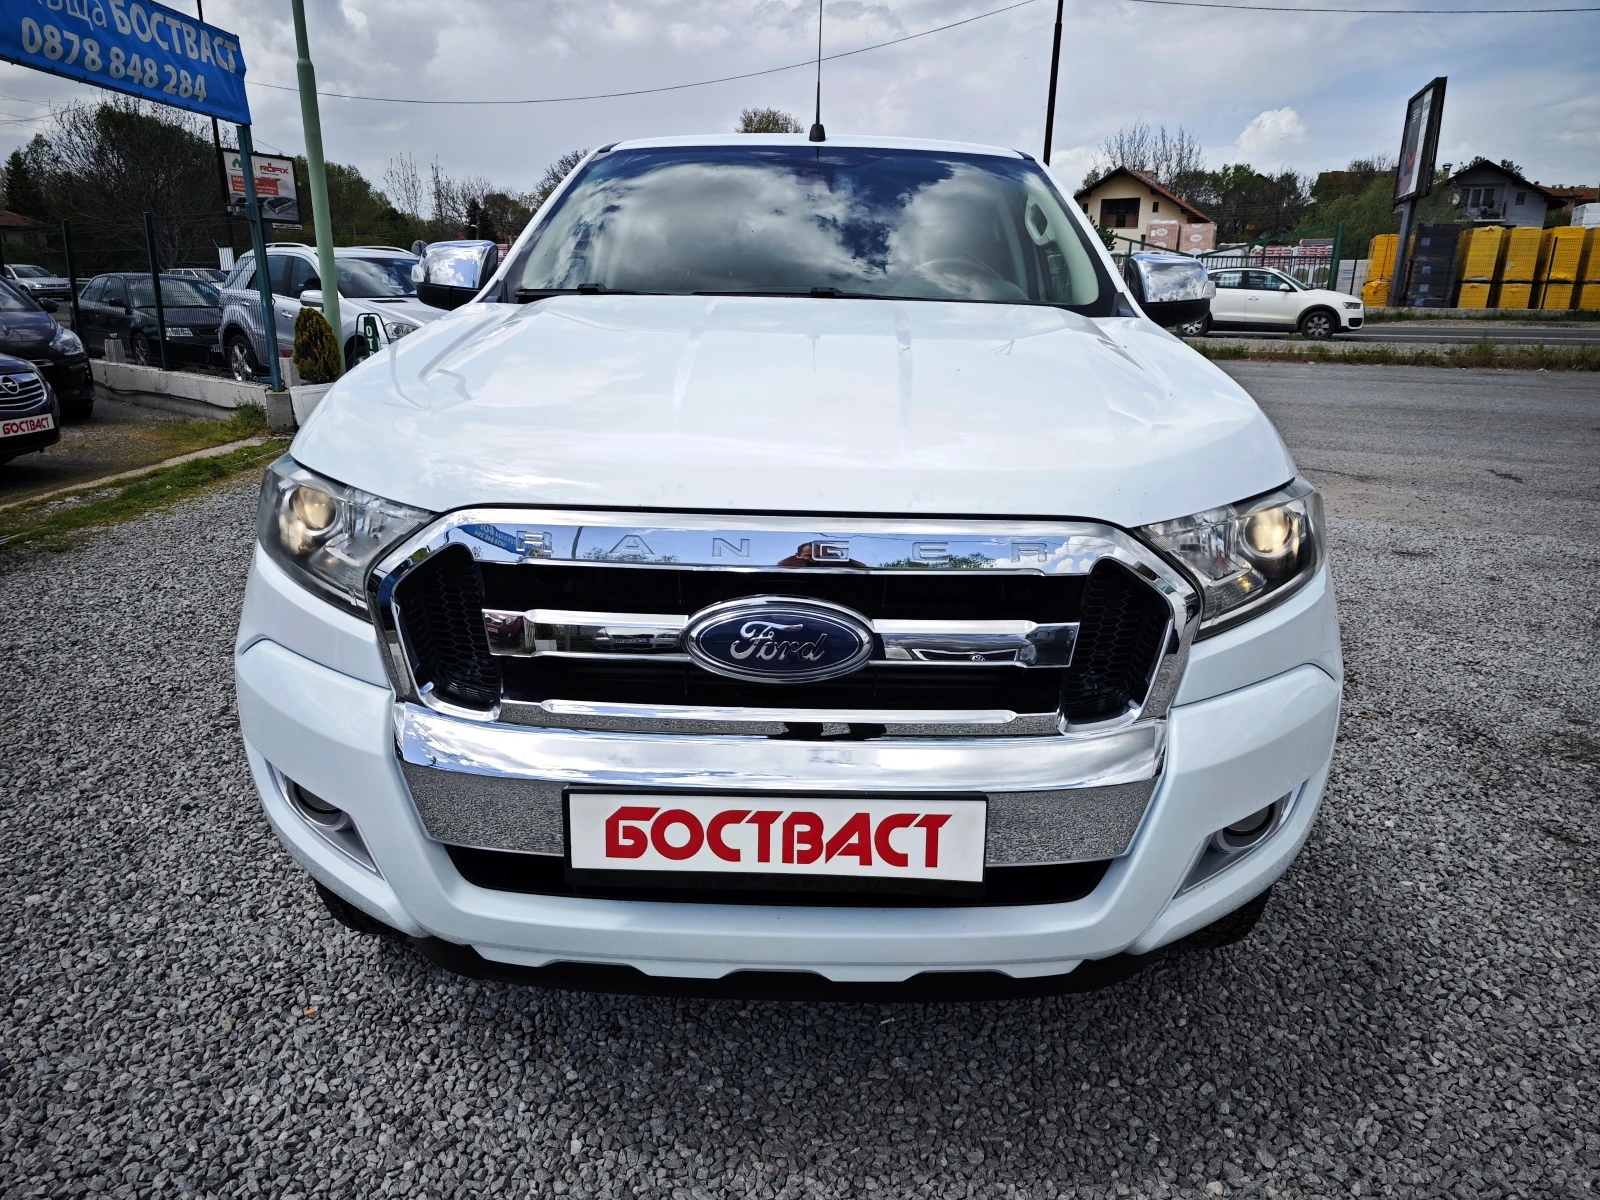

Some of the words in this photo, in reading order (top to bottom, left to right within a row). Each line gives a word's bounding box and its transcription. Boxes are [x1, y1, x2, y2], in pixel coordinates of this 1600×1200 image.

[21, 16, 103, 72] 0878
[109, 46, 159, 88] 848
[162, 64, 208, 102] 284
[109, 0, 238, 74] БОСТВАСТ
[2, 416, 50, 435] БОСТВАСТ
[515, 530, 1049, 563] RANGER
[730, 620, 828, 662] Ford
[605, 806, 953, 868] БОСТВАСТ
